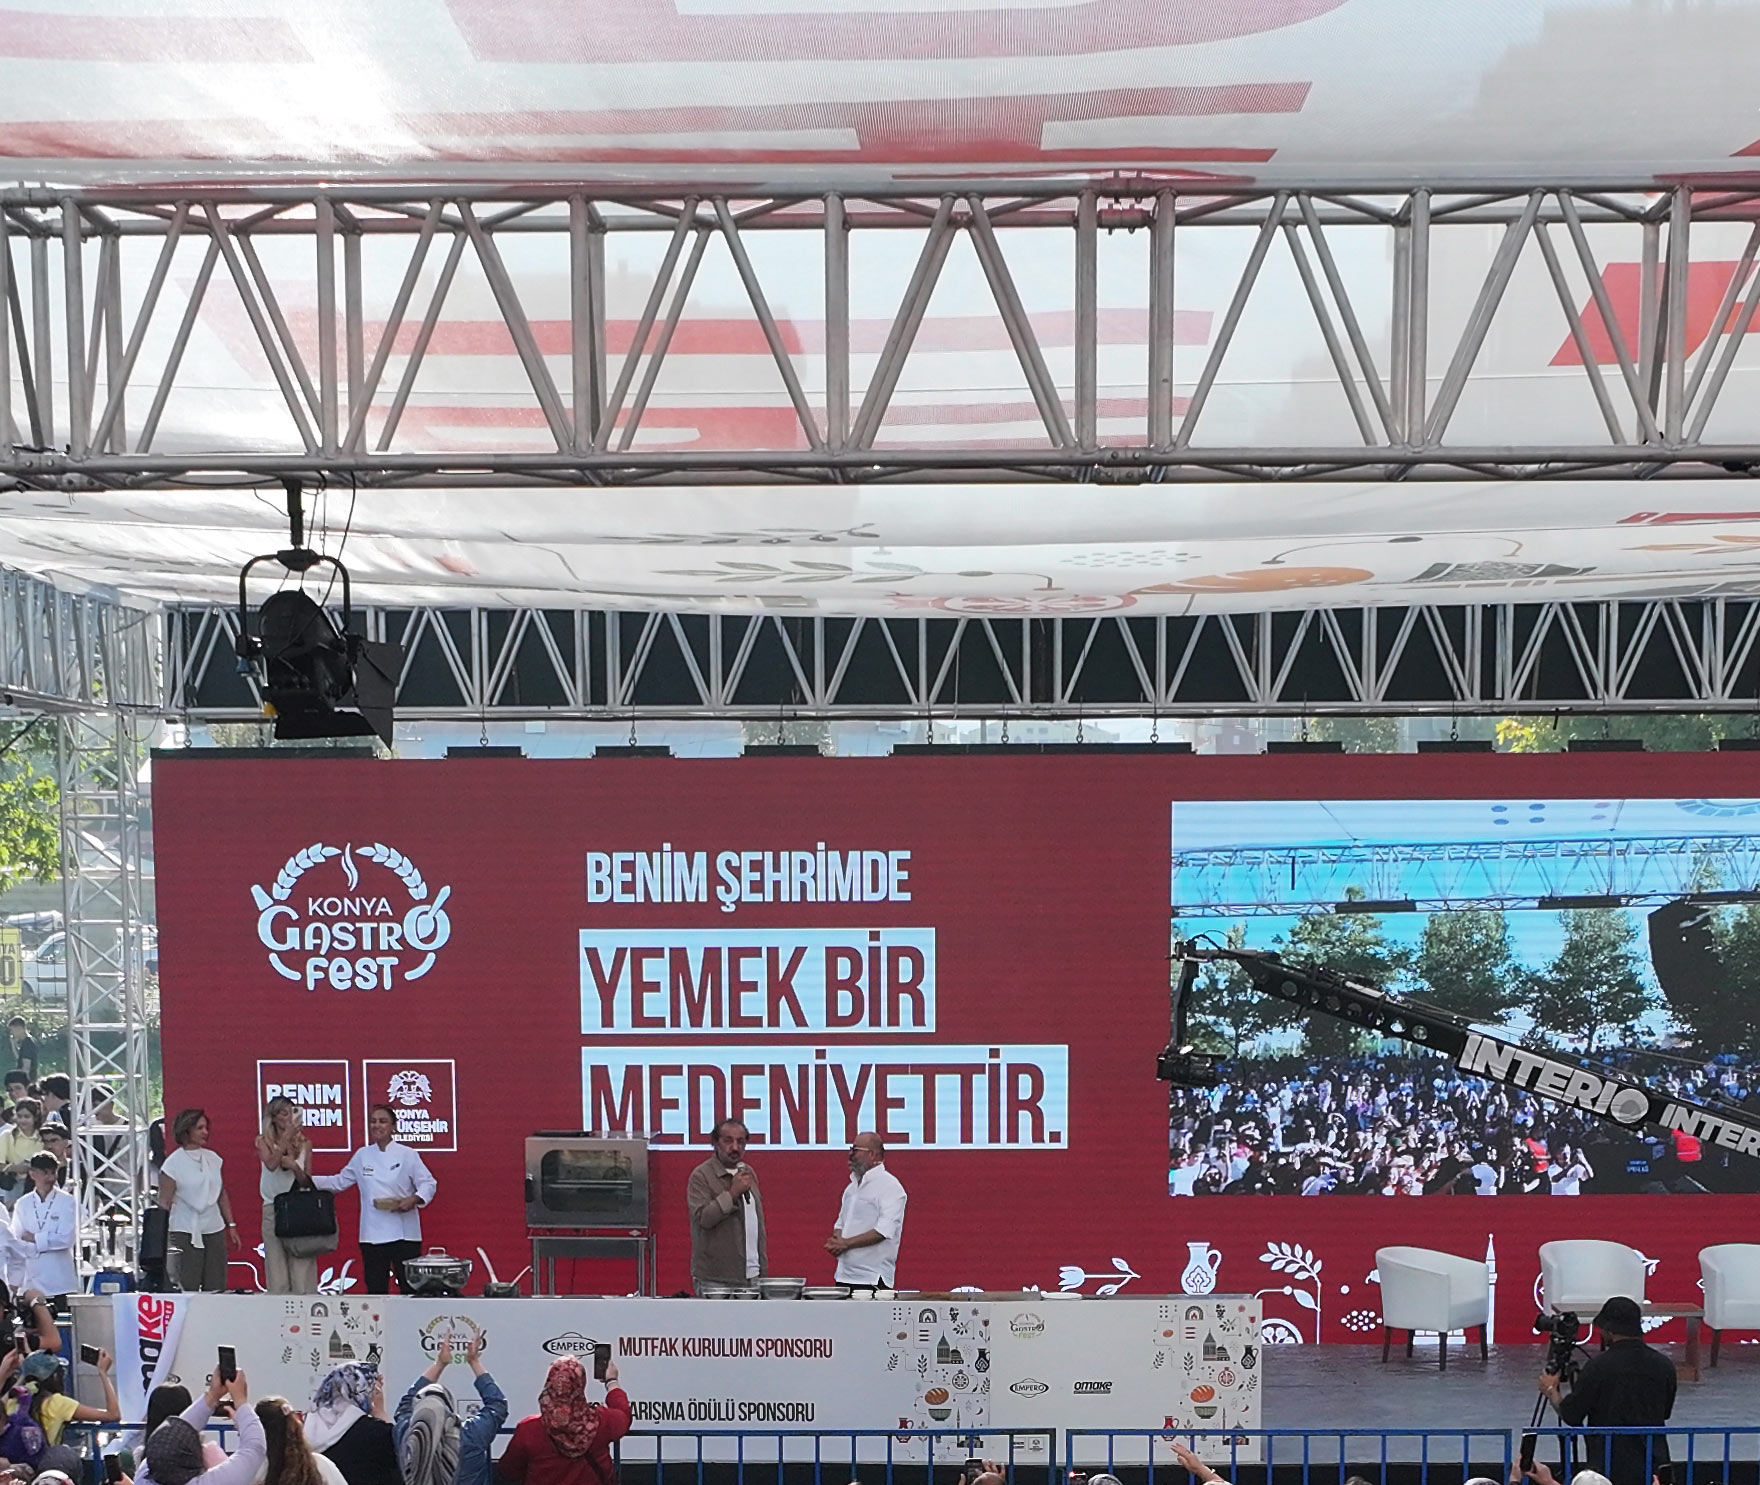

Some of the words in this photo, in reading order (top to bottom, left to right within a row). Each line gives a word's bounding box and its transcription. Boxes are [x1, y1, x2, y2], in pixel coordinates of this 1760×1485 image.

[587, 843, 707, 903] BENİM
[716, 842, 911, 912] ŞEHRİMDE
[308, 897, 393, 916] KONYA
[585, 946, 809, 1028] YEMEK
[826, 930, 927, 1028] BİR
[1459, 1034, 1649, 1124] INTERIO
[590, 1047, 1062, 1147] MEDENİYETTİR.
[396, 1118, 449, 1134] ÜKŞEHİR
[551, 1341, 595, 1351] EMPERO
[619, 1337, 679, 1357] MUTFAK
[682, 1337, 752, 1358] KURULUM
[756, 1338, 833, 1358] SPONSORU
[1014, 1384, 1045, 1392] EMPERO
[1073, 1381, 1113, 1391] omake
[628, 1401, 686, 1424] ARIŞMA
[688, 1398, 735, 1421] ÖDÜLÜ
[738, 1402, 815, 1422] SPONSORU
